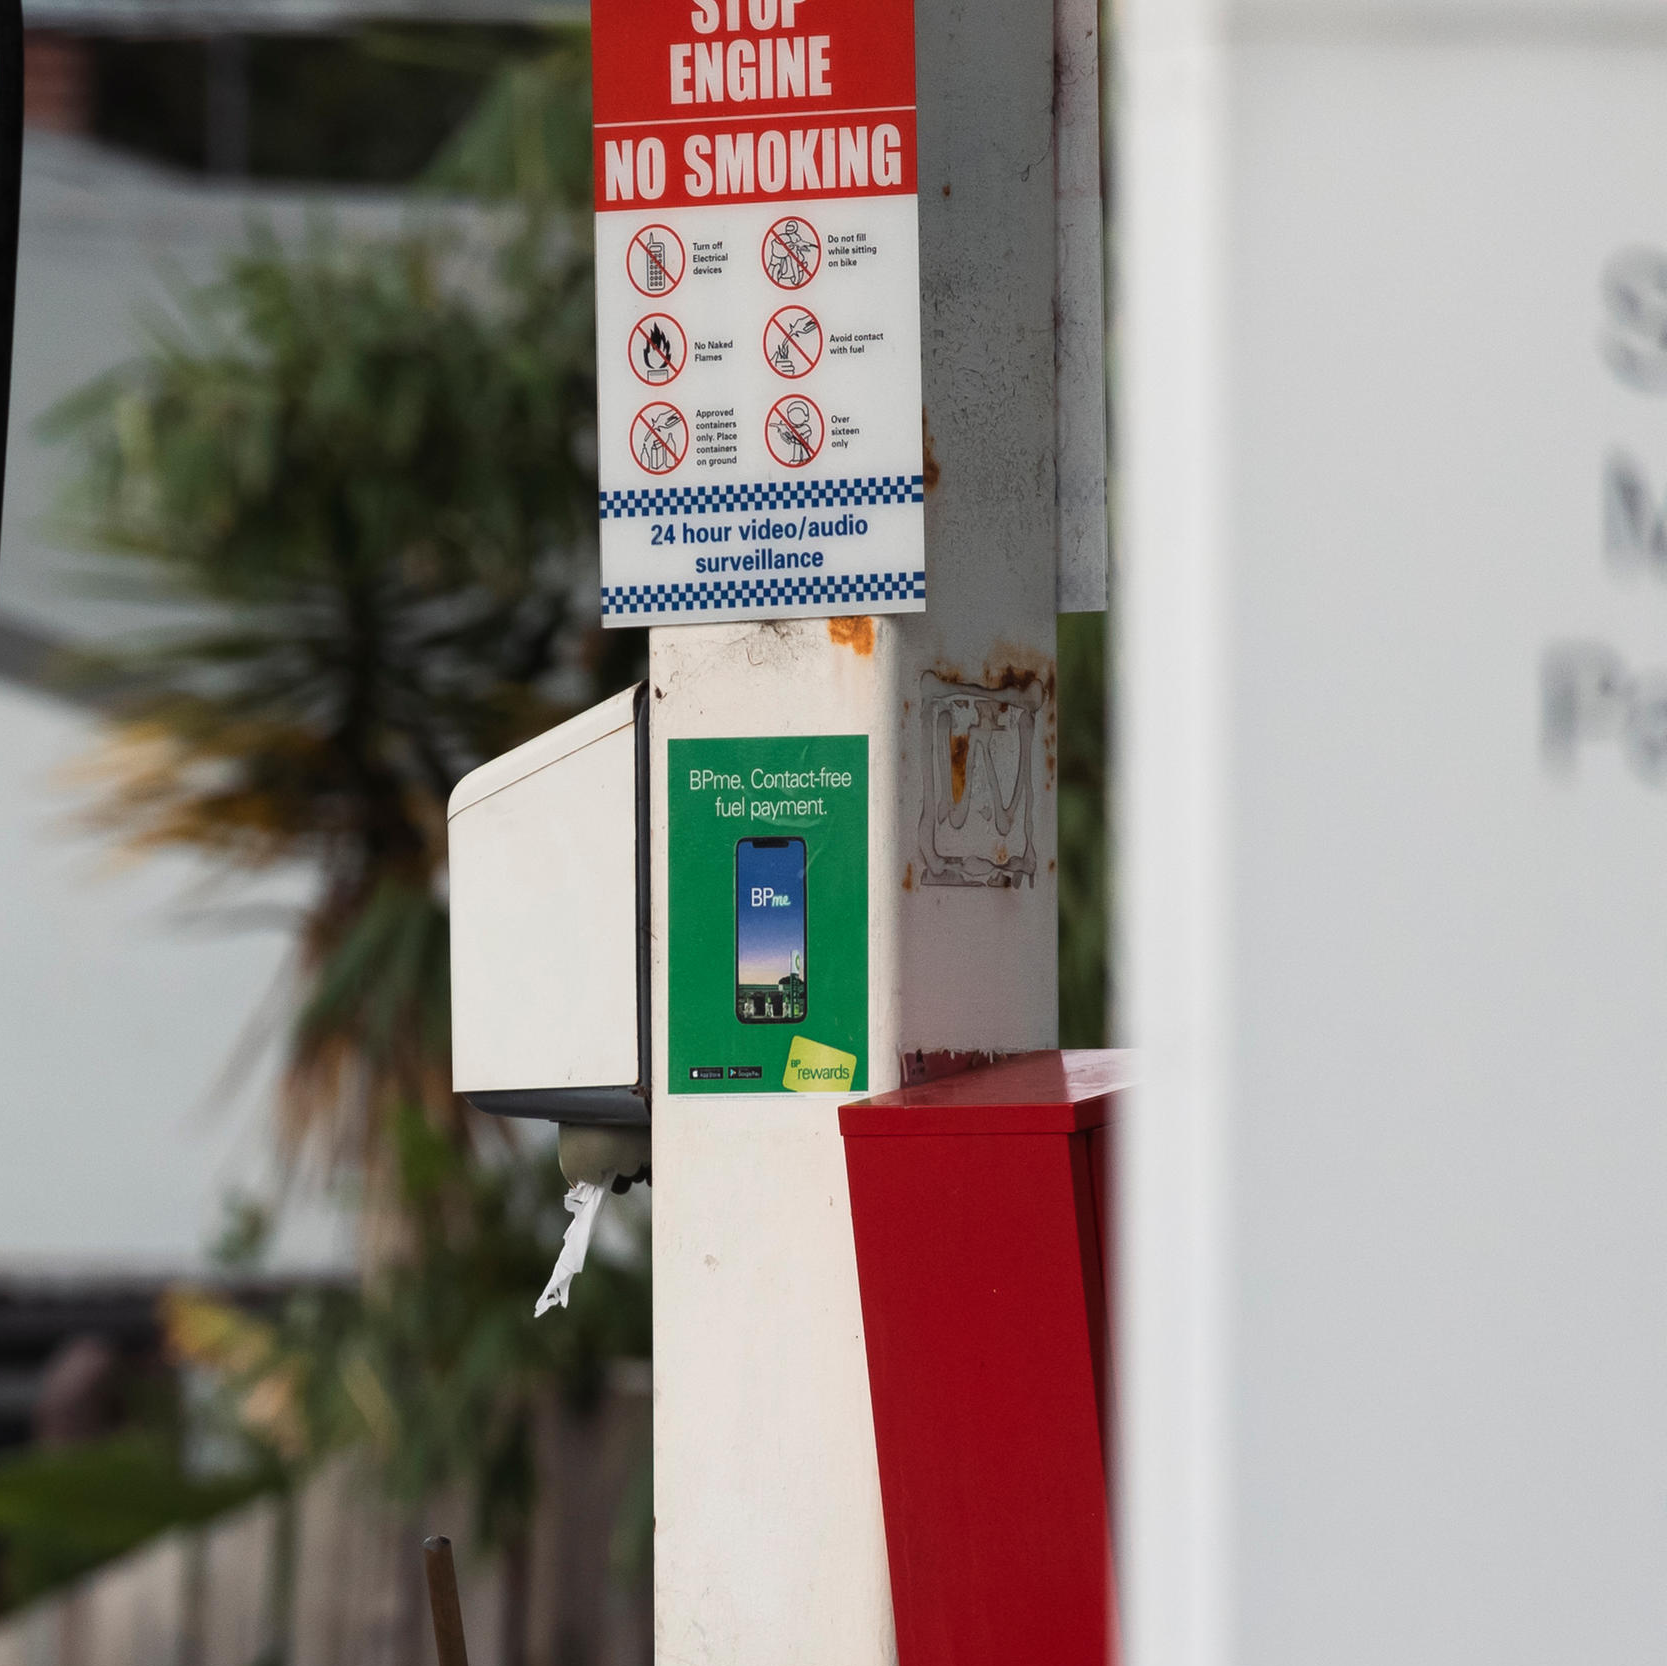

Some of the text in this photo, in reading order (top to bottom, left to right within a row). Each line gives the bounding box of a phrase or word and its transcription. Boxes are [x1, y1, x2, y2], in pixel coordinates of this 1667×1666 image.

[669, 35, 833, 105] ENGINE
[604, 123, 903, 201] NO SMOKING
[827, 233, 867, 243] Do not fill
[692, 241, 724, 252] Turn off
[828, 245, 877, 256] while sitting
[692, 252, 729, 263] Electrical
[828, 257, 858, 268] on bike
[692, 265, 723, 275] devices
[829, 332, 885, 344] Avoid contact
[694, 340, 734, 350] No Naked
[829, 344, 865, 355] with fuel
[694, 353, 723, 363] Flames
[695, 407, 734, 420] Approved
[830, 415, 851, 424] Over
[695, 420, 737, 431] containers
[830, 426, 860, 436] sixteen
[716, 432, 738, 442] Place
[695, 444, 738, 455] containers
[830, 439, 849, 449] only
[696, 455, 738, 467] on ground
[650, 513, 869, 546] 24 hour video/audio
[695, 548, 825, 574] surveillance
[689, 767, 853, 791] BPme. Contact-free
[714, 796, 828, 821] fuel payment.
[797, 1064, 850, 1081] rewards
